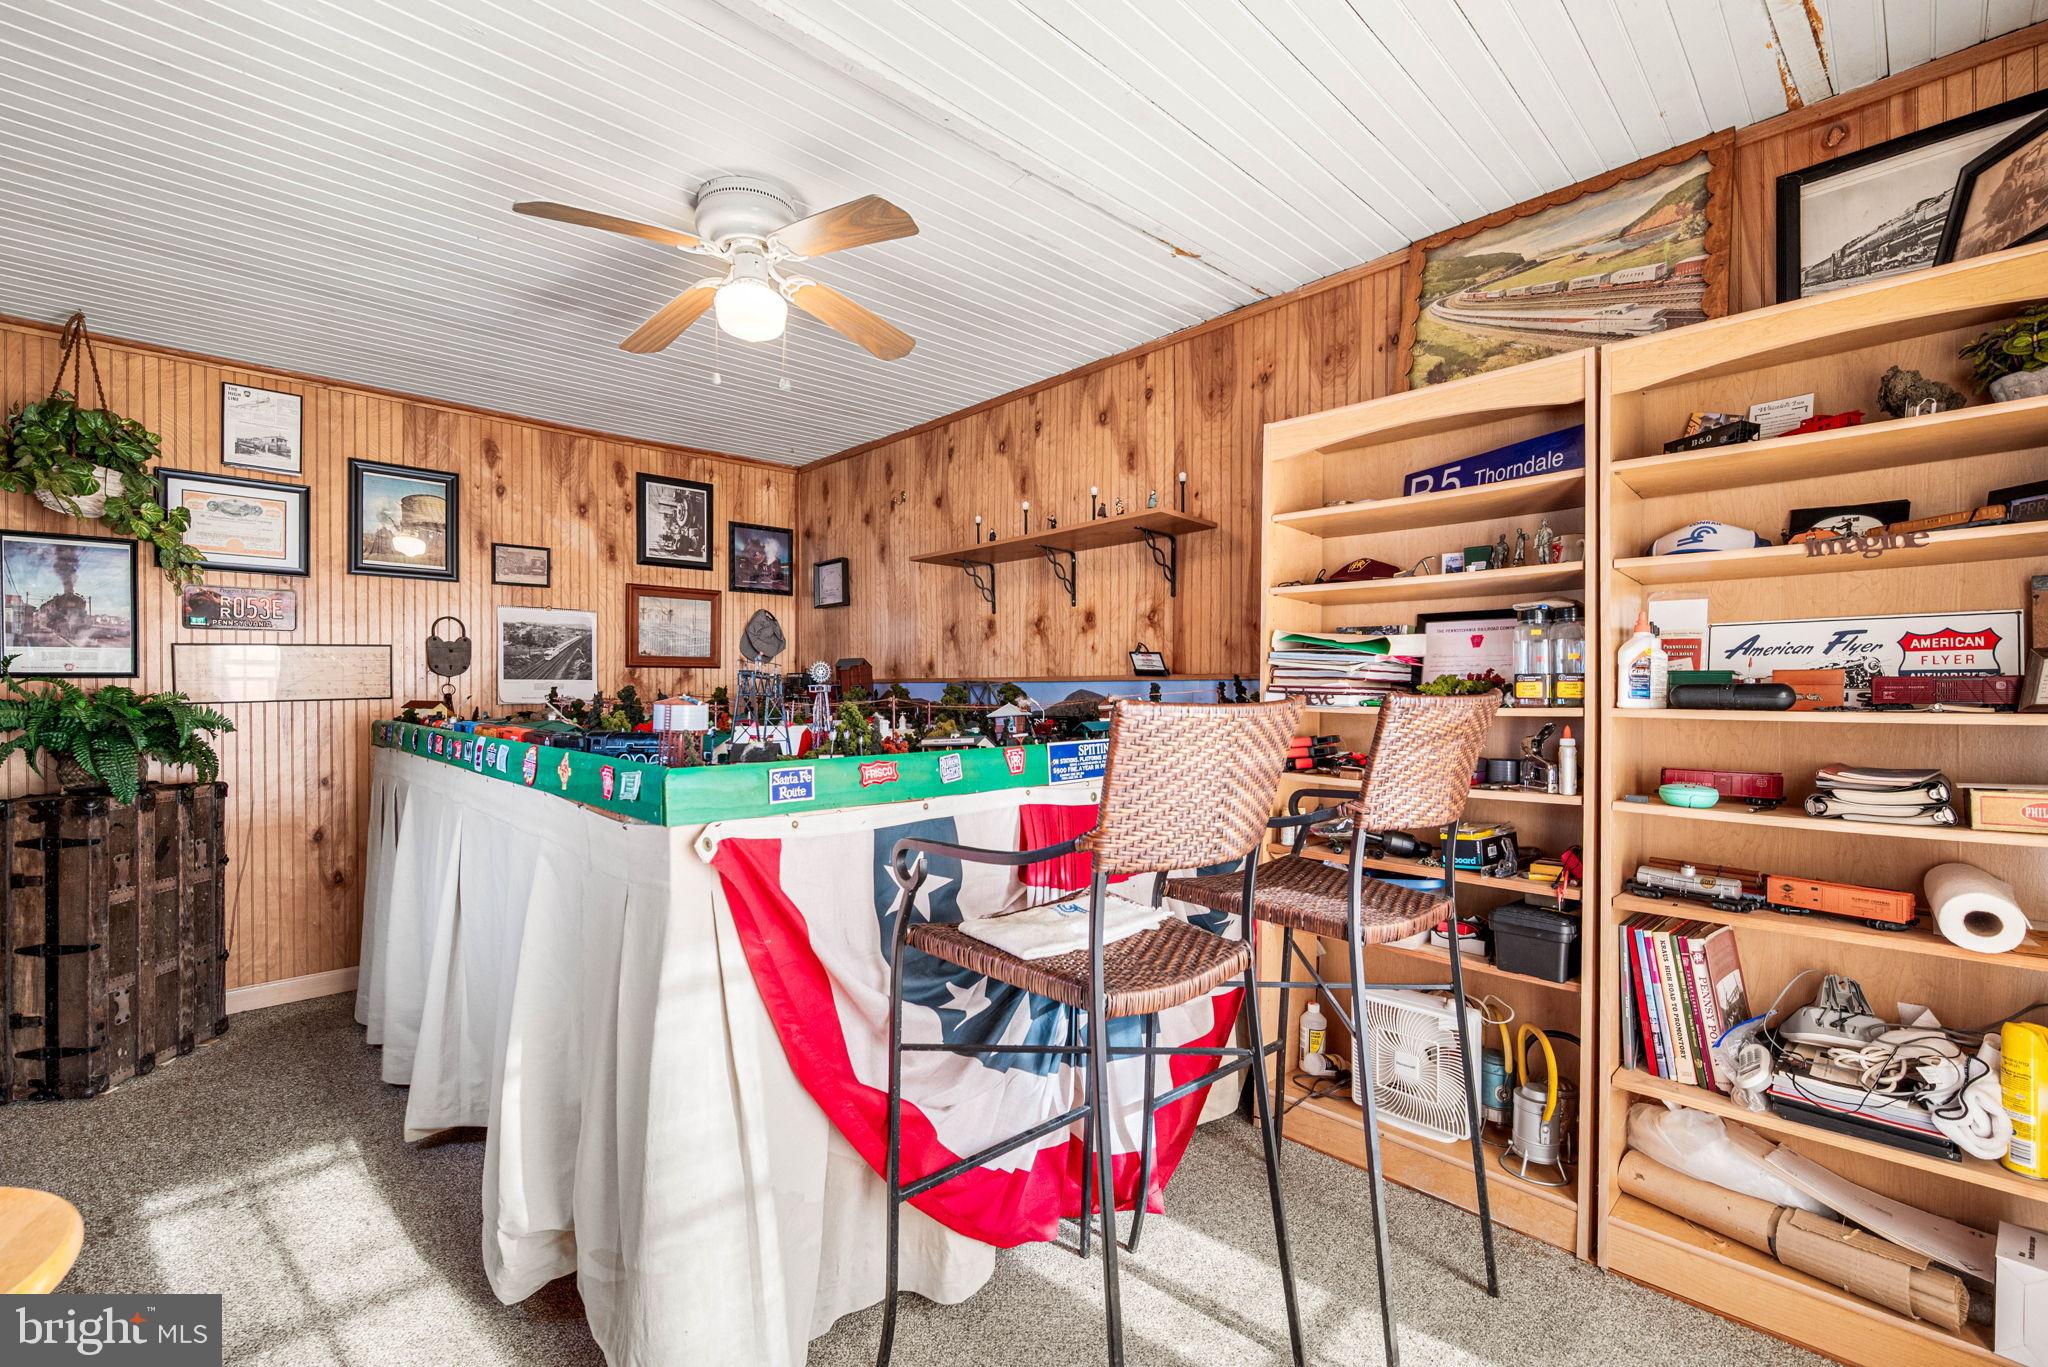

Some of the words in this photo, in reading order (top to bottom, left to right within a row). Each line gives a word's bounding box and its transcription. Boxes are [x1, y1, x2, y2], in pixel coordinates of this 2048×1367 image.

[1691, 435, 1712, 447] B&O
[1474, 451, 1564, 485] Thorndale
[1805, 531, 1929, 558] imagine
[1724, 634, 1814, 659] American
[1823, 629, 1883, 656] Flyer
[1910, 636, 1985, 649] AMERICAN
[1920, 654, 1975, 665] FLYER
[1078, 743, 1109, 756] SPITTIN
[773, 772, 798, 785] Santa
[799, 770, 812, 783] Fe
[865, 766, 893, 779] FRISCO
[779, 786, 807, 799] Route
[1660, 940, 1669, 962] KRAUS
[1664, 965, 1673, 982] HIGH
[1668, 983, 1676, 1001] ROAD
[1699, 977, 1714, 1021] PENNSY
[1672, 1003, 1678, 1012] TO
[1673, 1012, 1687, 1060] PROMONTORY
